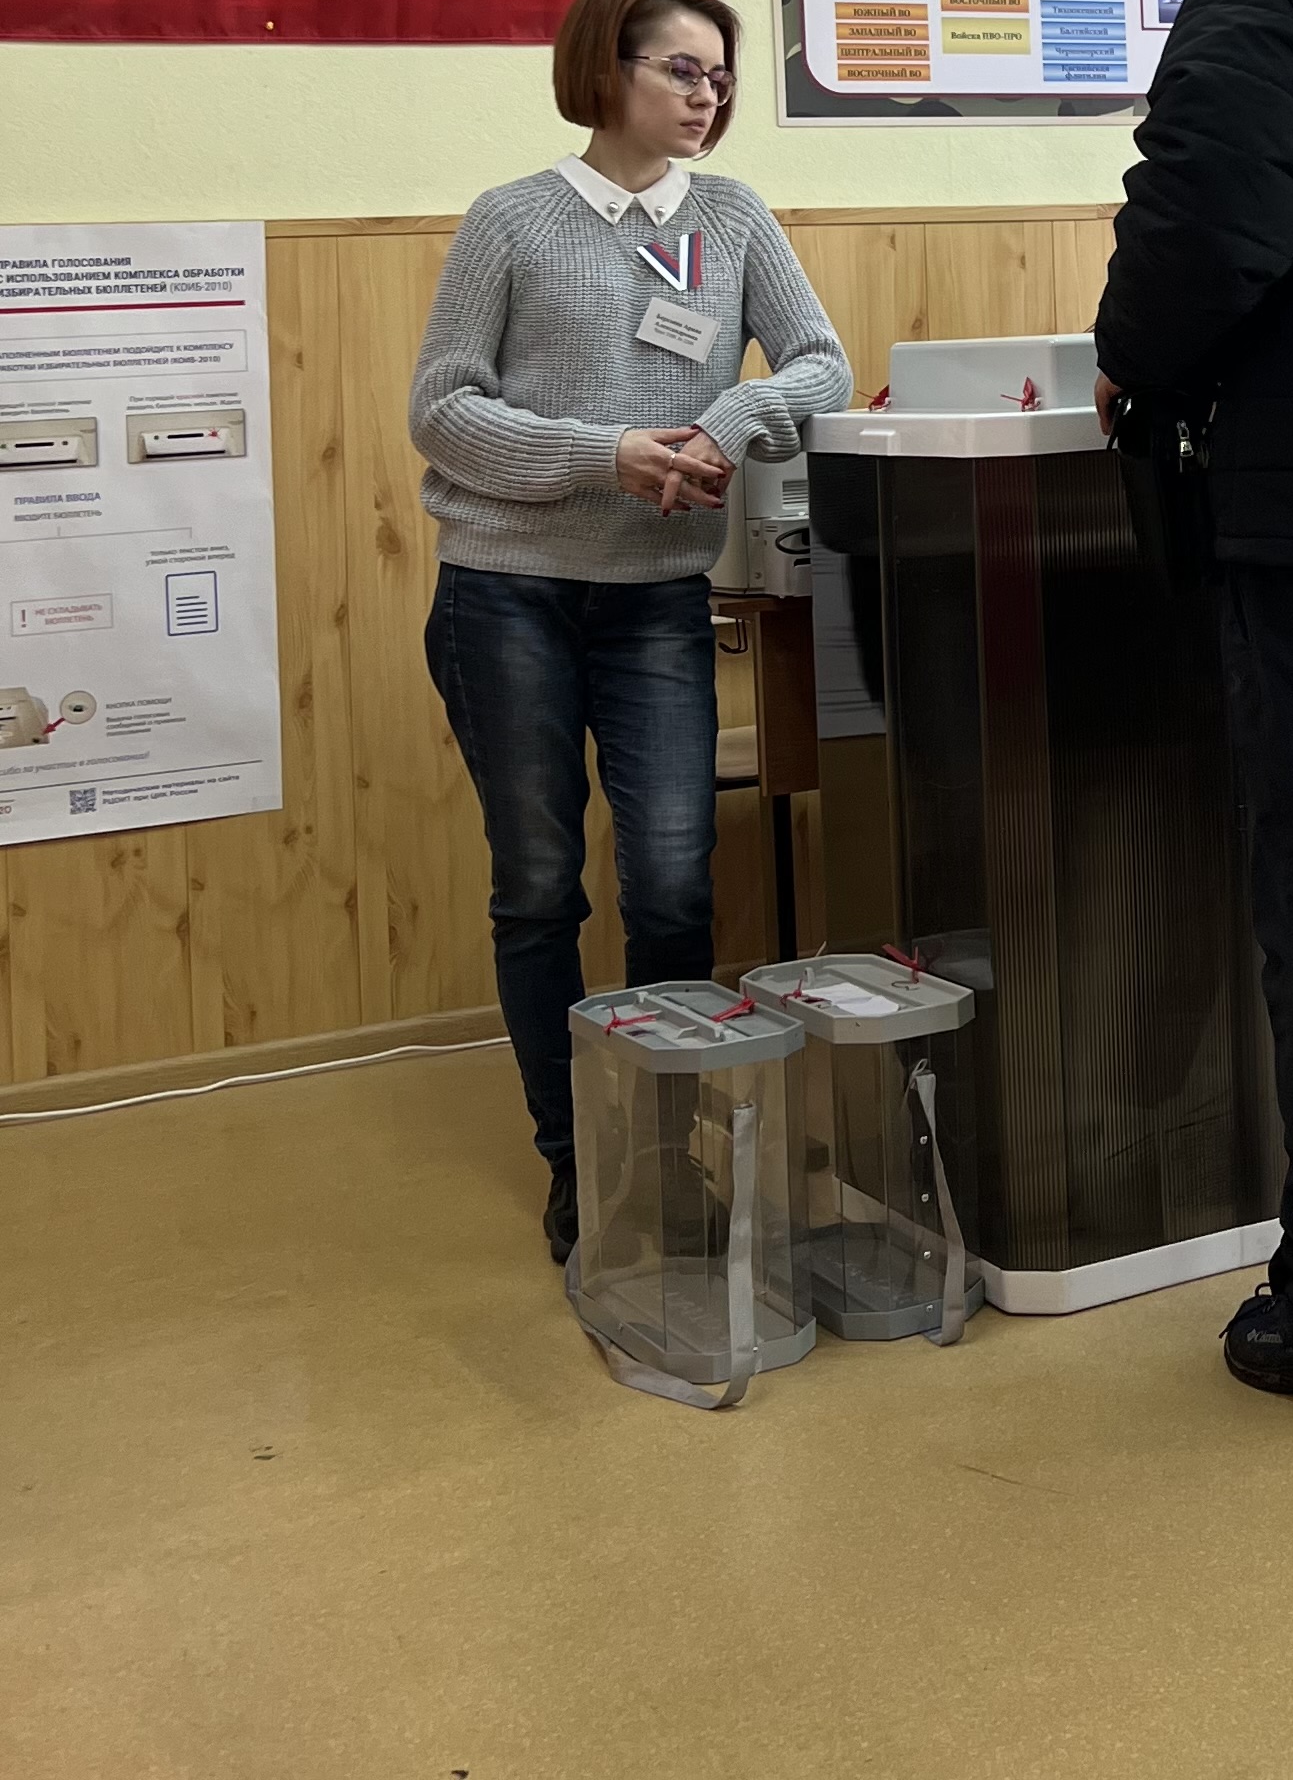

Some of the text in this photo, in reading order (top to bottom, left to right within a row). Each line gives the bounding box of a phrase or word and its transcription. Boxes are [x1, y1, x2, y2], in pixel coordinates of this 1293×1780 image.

[853, 6, 911, 17] ЮЖНЫЙ ВО
[848, 26, 917, 37] ЗАПАДНЫЙ ВО
[951, 32, 1022, 41] Войска ПВО-ПРО
[1059, 27, 1108, 36] Балтийский
[840, 46, 926, 57] ЦЕНТРАЛЬНЫЙ ВО
[847, 66, 922, 78] ВОСТОЧНЫЙ ВО
[52, 257, 131, 269] ГОЛОСОВАНИЯ
[6, 270, 111, 283] ИСПОЛЬЗОВАНИЕМ
[114, 269, 180, 281] КОМПЛЕКСА
[183, 267, 244, 279] ОБРАБОТКИ
[95, 282, 167, 295] БЮЛЛЕТЕНЕЙ
[169, 281, 233, 294] (КОИБ-2010)
